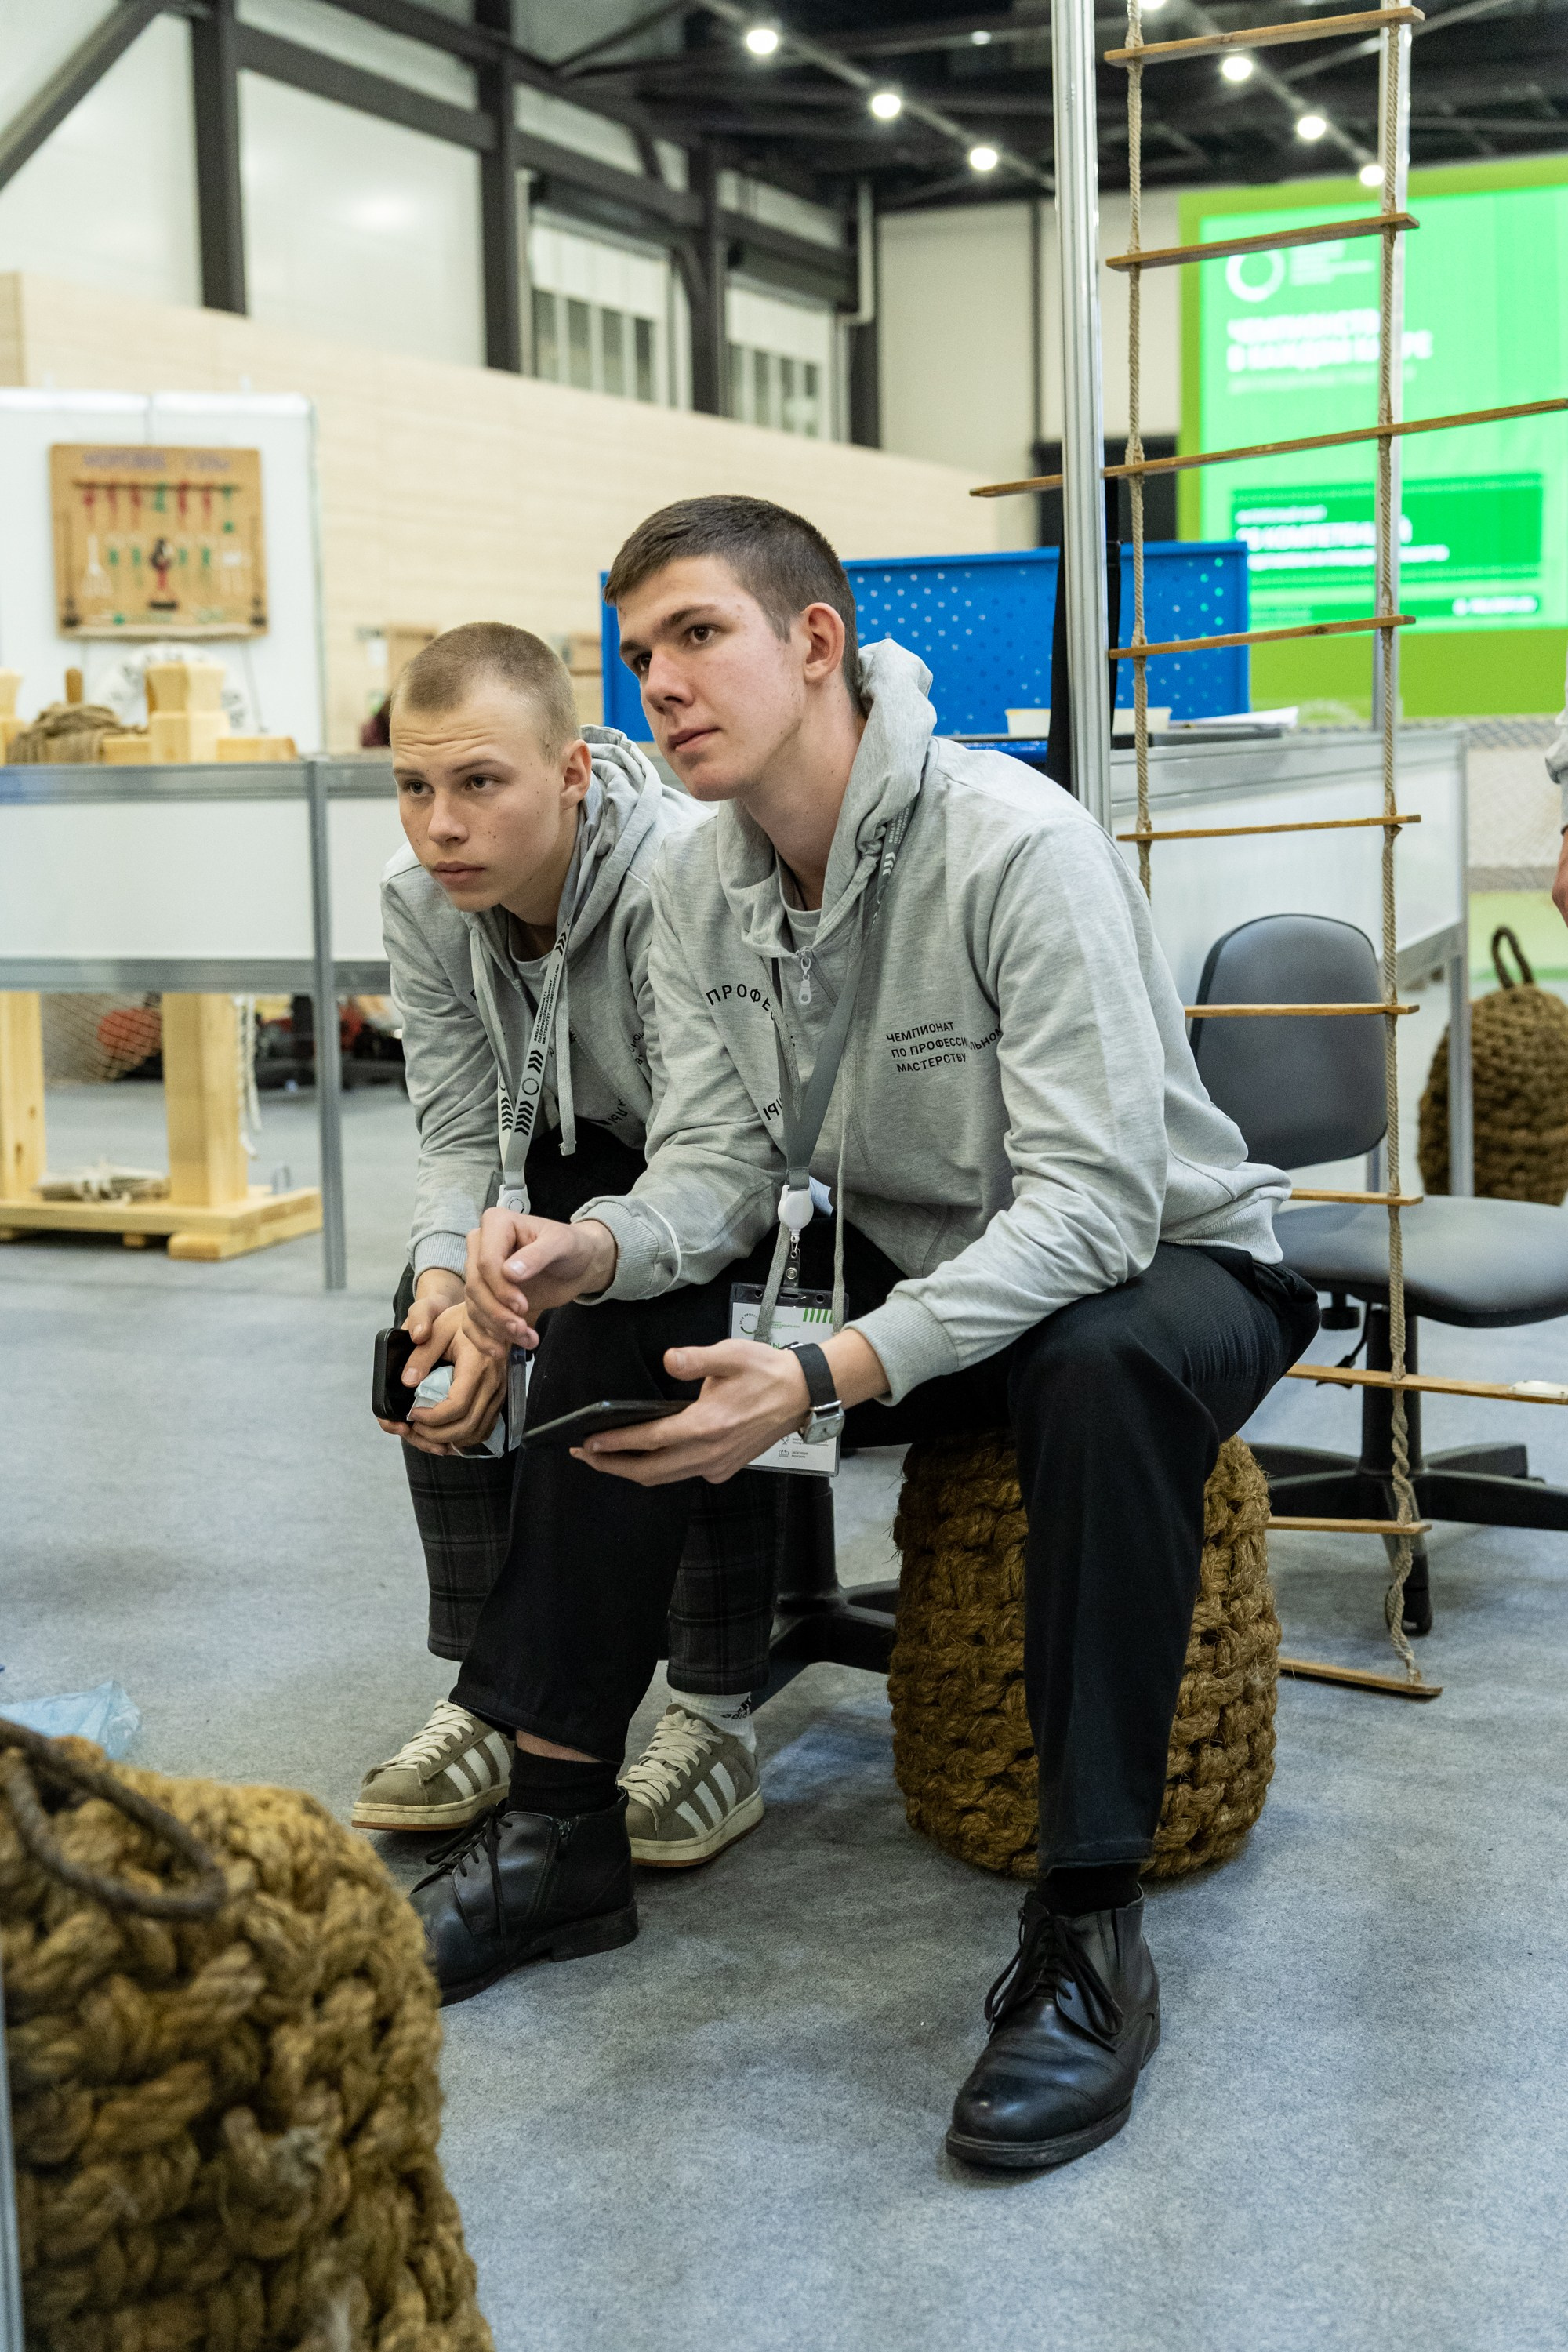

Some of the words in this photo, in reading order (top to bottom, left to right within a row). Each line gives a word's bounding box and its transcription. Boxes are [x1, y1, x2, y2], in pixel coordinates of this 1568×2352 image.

[886, 1022, 954, 1043] ЧЕМПИОНАТ
[891, 1048, 907, 1058] ПО
[896, 1053, 967, 1073] МАСТЕРСТВУ
